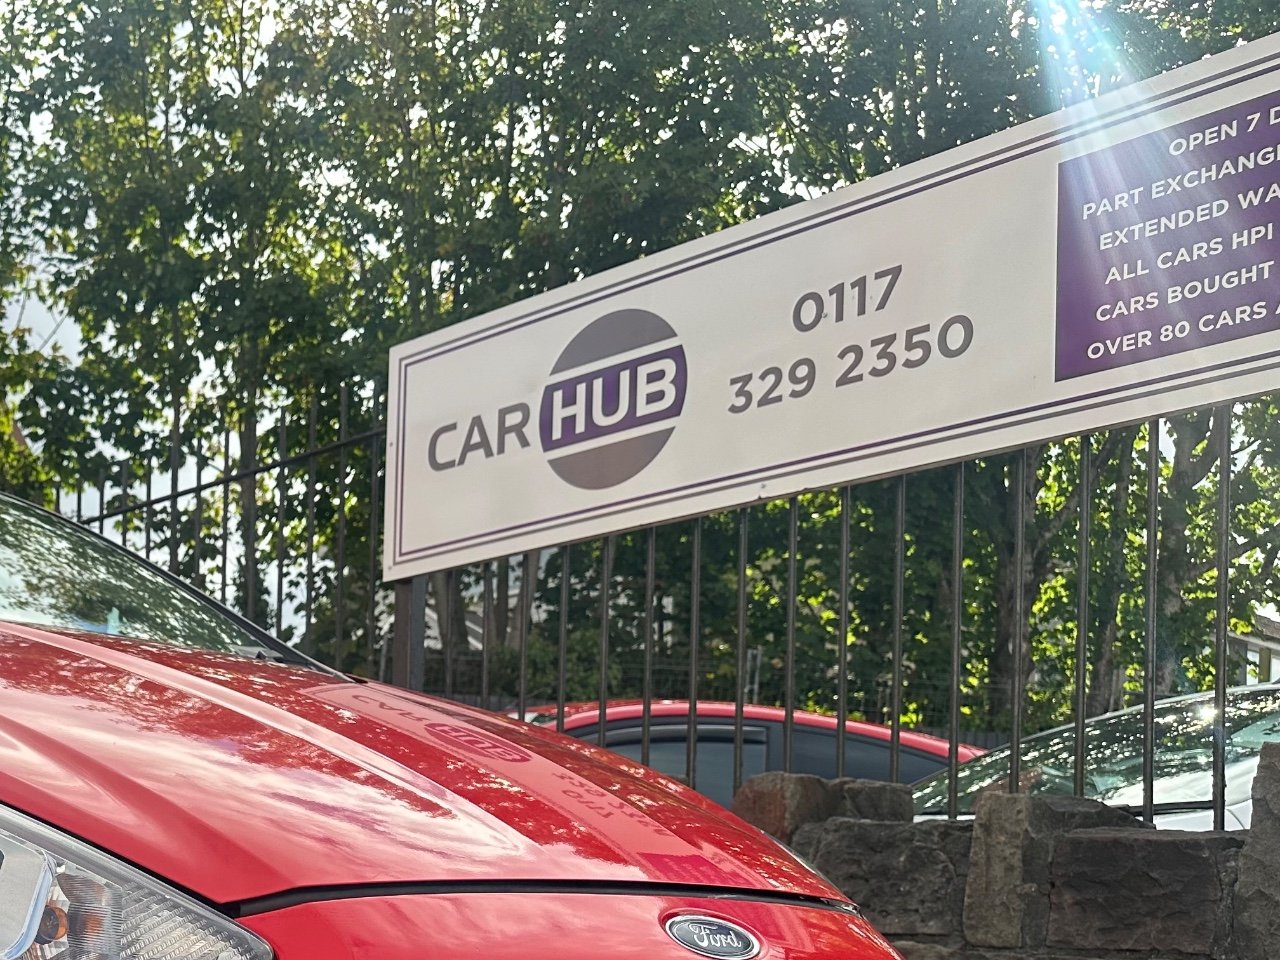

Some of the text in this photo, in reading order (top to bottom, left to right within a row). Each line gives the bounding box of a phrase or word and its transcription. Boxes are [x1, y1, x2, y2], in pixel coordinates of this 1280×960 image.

[1168, 119, 1238, 156] OPEN
[1246, 111, 1261, 133] 7
[1082, 144, 1280, 220] PART EXCHANG
[1099, 199, 1230, 251] EXTENDED
[1105, 222, 1274, 285] ALL CARS HPI
[792, 264, 904, 333] 0117
[1095, 260, 1275, 322] CARS BOUGHT
[1086, 329, 1152, 360] OVER
[1159, 319, 1191, 343] 80
[1198, 300, 1268, 334] CARS
[727, 313, 975, 414] 329 2350
[427, 358, 678, 472] CAR HUB
[688, 922, 742, 948] Ford
